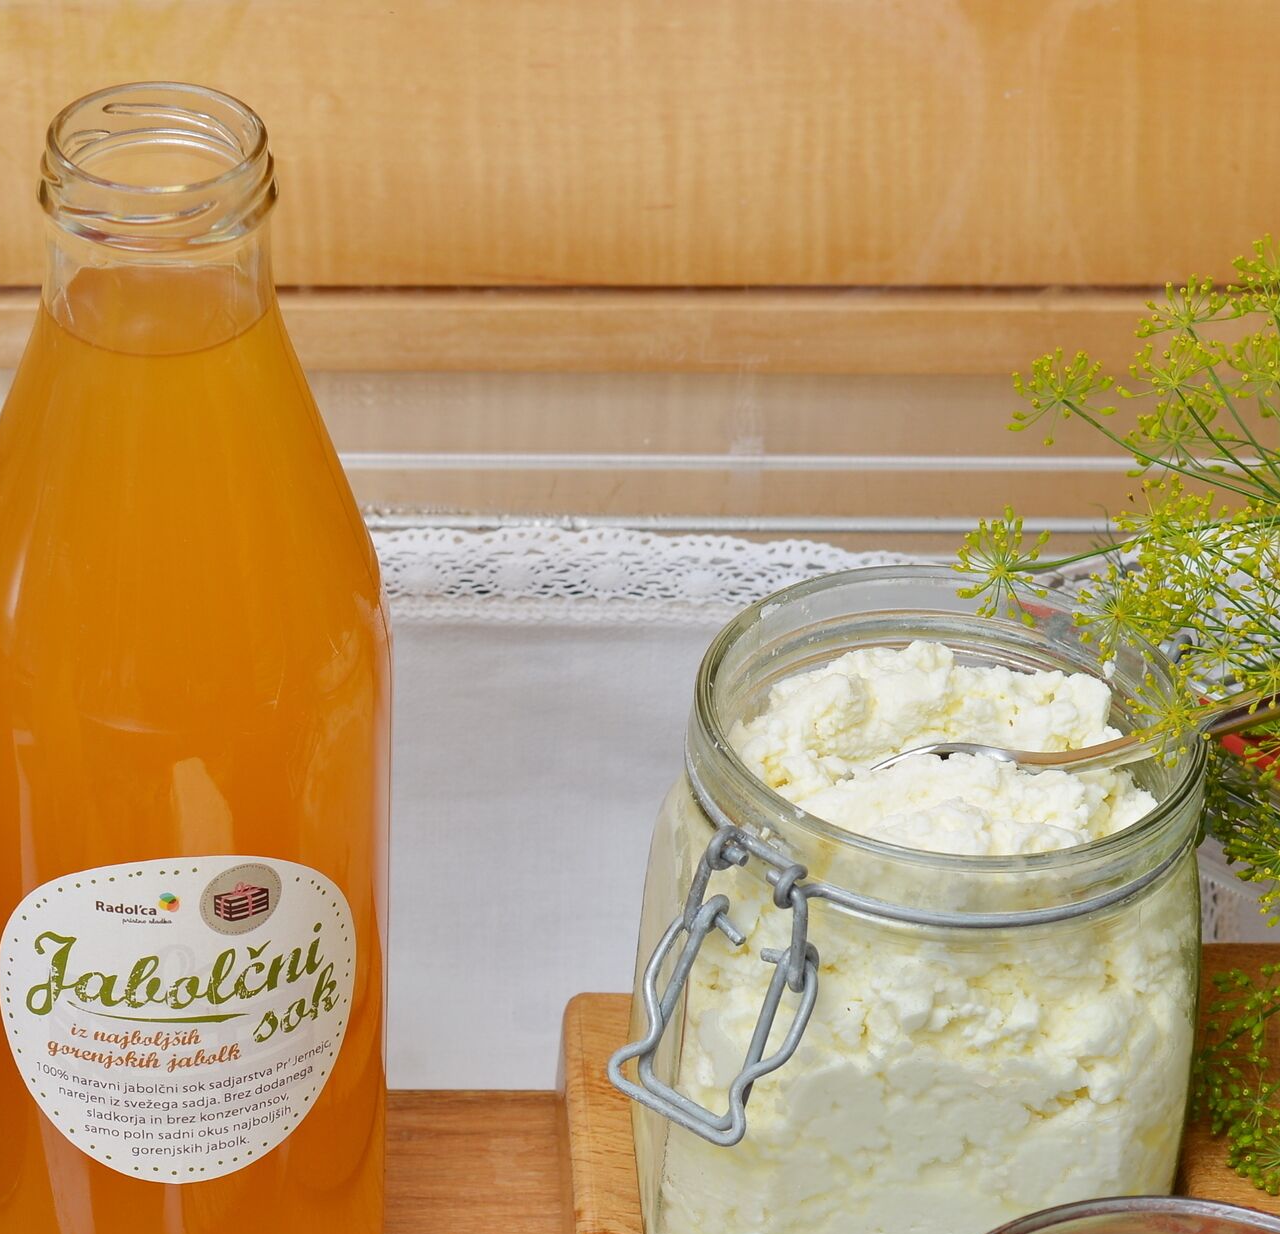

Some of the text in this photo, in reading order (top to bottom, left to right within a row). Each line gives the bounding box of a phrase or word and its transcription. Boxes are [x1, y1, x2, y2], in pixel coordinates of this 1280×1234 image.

[26, 922, 324, 1015] Jabolčni
[253, 962, 340, 1043] sok
[71, 1023, 202, 1051] iz najboljših
[47, 1040, 242, 1073] gorenjskih jabolk
[37, 1061, 69, 1081] 100%
[72, 1075, 120, 1091] naravni
[123, 1083, 179, 1094] jabolčni
[182, 1081, 206, 1093] sok
[209, 1067, 273, 1089] sadjarstva
[276, 1057, 291, 1073] Pr'
[58, 1065, 313, 1112] narejen iz svežega sadja. Brez dodanega
[84, 1105, 292, 1140] samo poln sadni okus najboljših
[86, 1092, 290, 1126] sladkorja in brez konzervansov,
[131, 1135, 251, 1158] gorenjskih jabolk.
